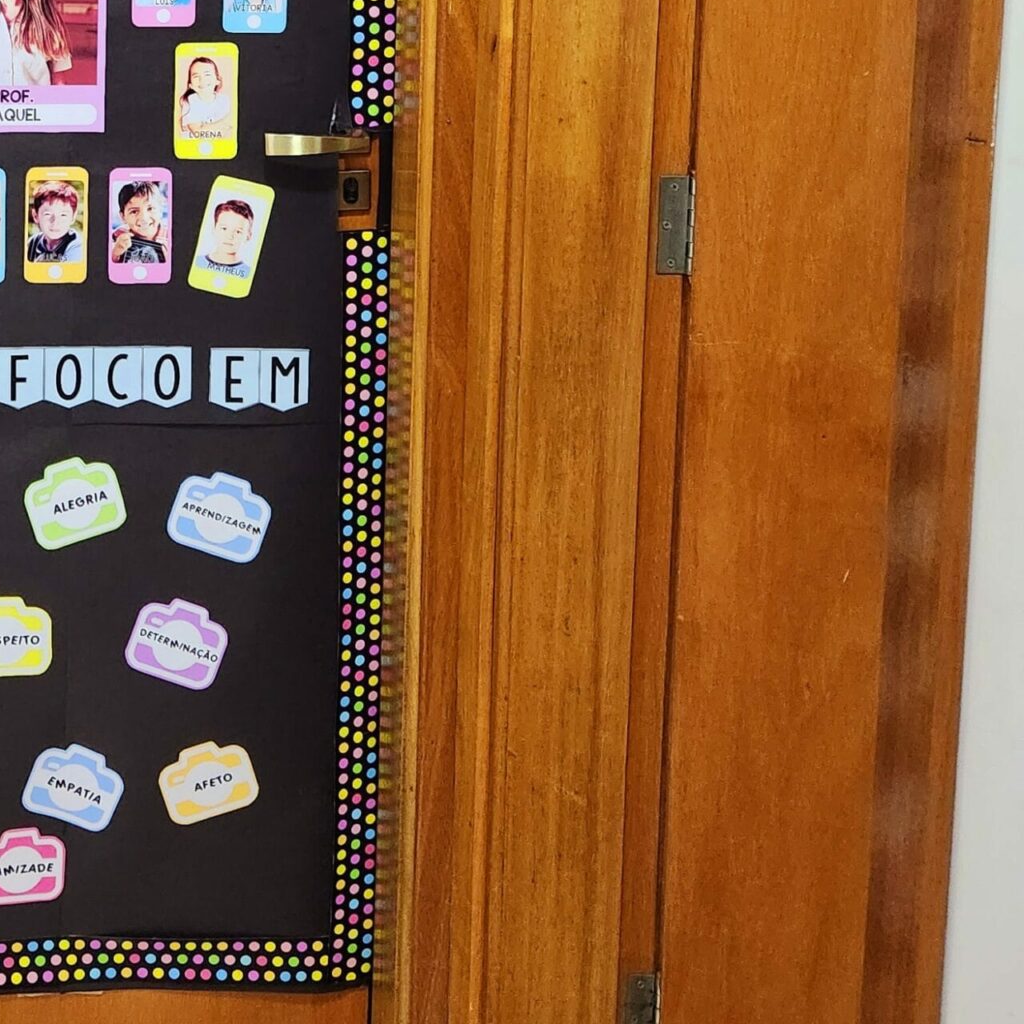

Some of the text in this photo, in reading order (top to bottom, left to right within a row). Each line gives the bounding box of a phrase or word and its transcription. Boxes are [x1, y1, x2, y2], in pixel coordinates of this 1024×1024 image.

[188, 131, 223, 139] LORENA
[206, 262, 246, 278] MATHEUS
[10, 353, 182, 402] FOCO
[225, 355, 301, 405] EM
[53, 490, 108, 516] ALEGRIA
[182, 501, 263, 536] APRENDIZAGEM
[139, 627, 219, 664] DETERMINAÇÃO
[47, 776, 102, 805] EMPATIA
[194, 773, 234, 793] AFETO
